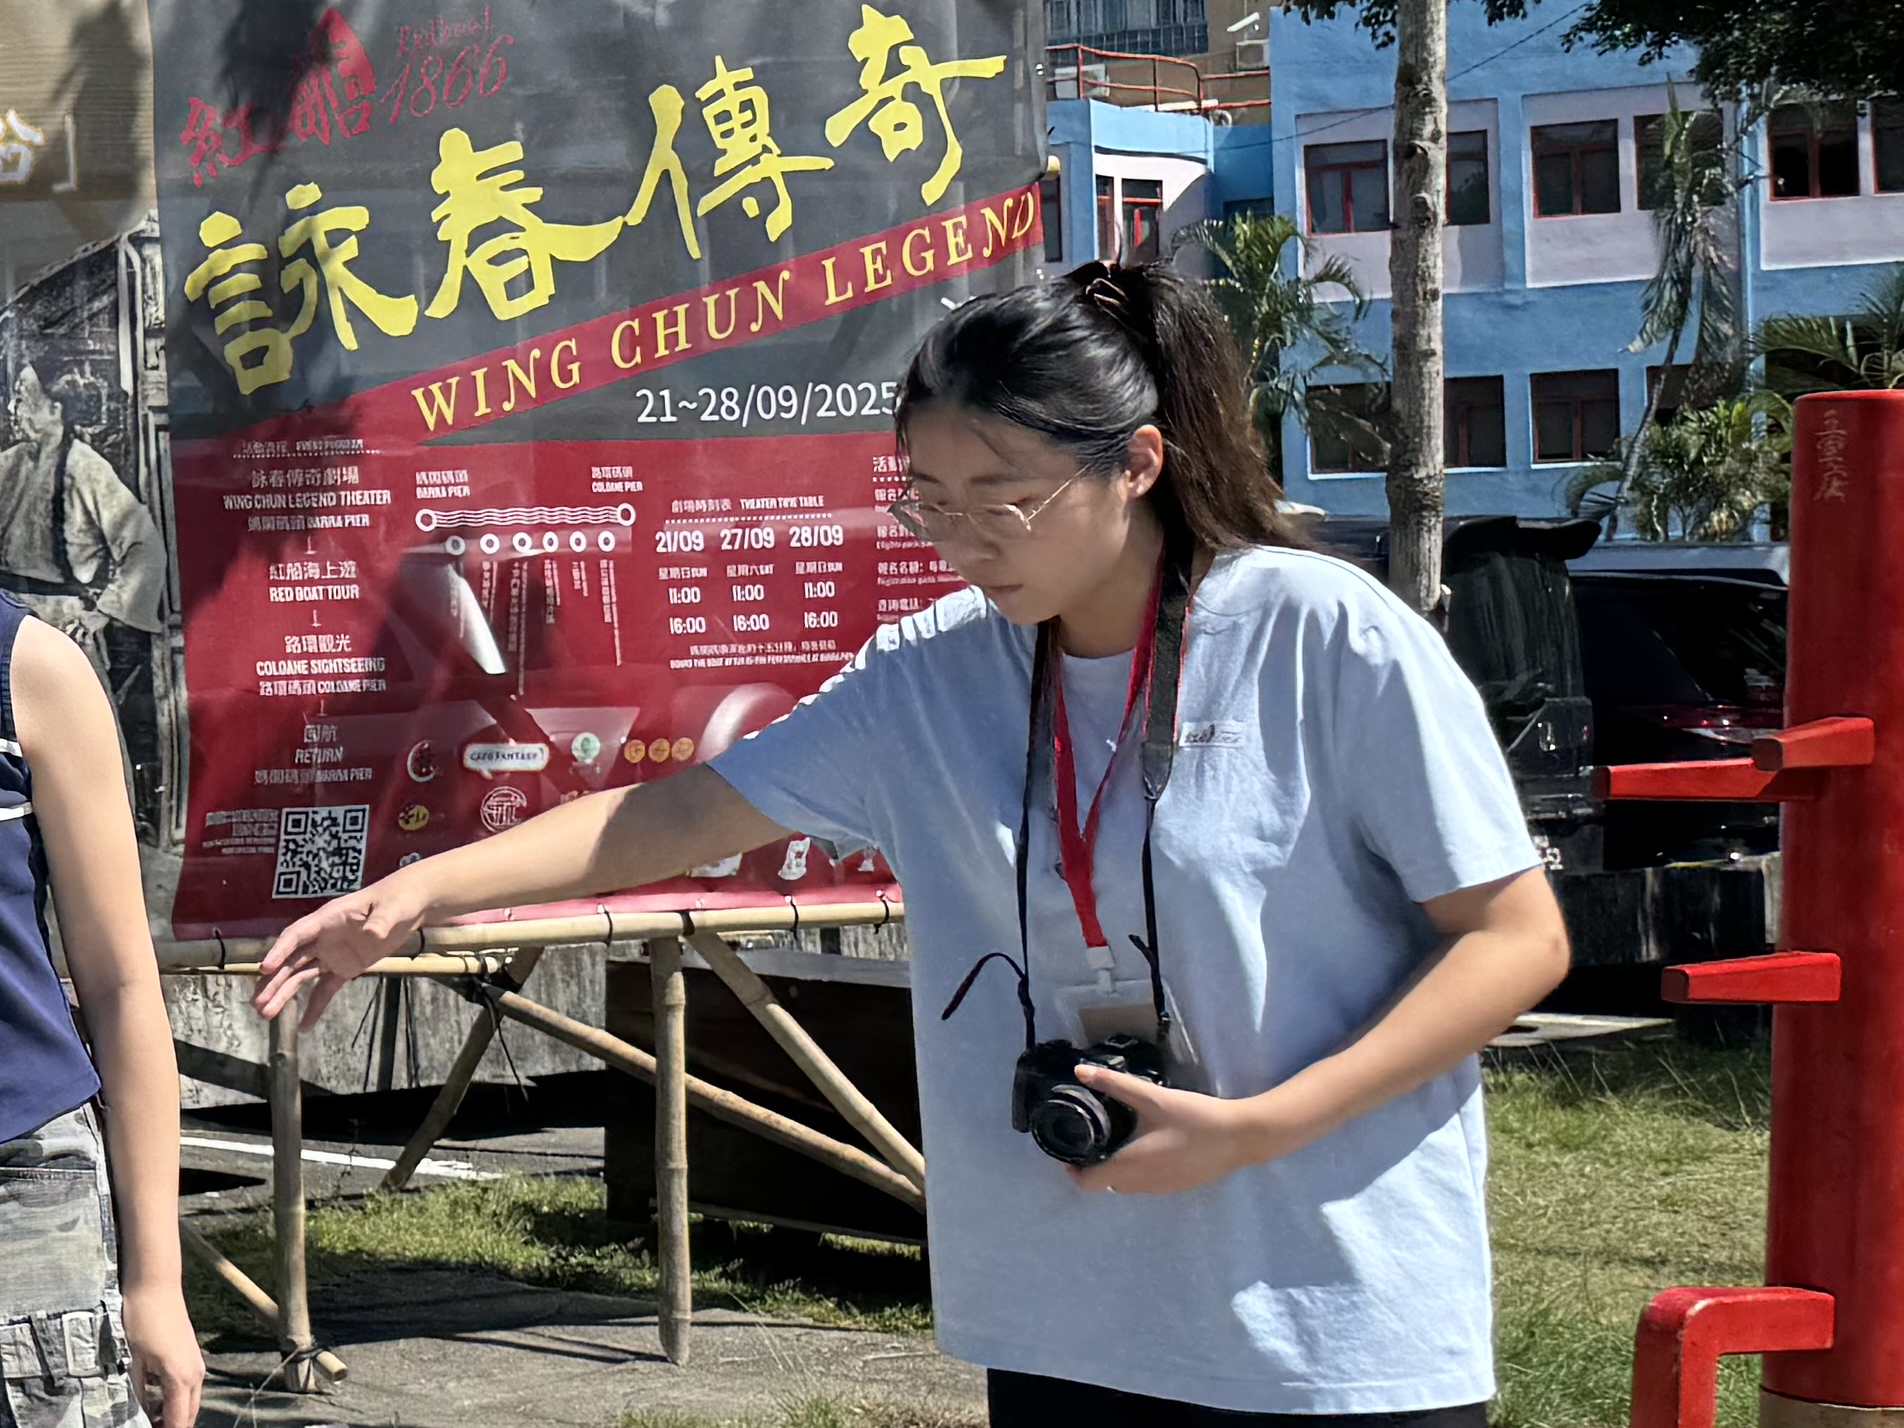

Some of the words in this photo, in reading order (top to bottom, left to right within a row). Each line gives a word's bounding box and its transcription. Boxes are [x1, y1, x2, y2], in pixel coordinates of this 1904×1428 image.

[379, 34, 515, 124] 1866
[184, 2, 1008, 396] 詠春傳奇
[411, 338, 582, 432] WING
[610, 269, 792, 370] CHUN
[822, 191, 1037, 308] LEGEND
[339, 489, 392, 507] THEATER
[655, 529, 705, 553] 21/09
[719, 527, 775, 551] 27/09
[789, 524, 844, 548] 28/09
[269, 586, 294, 603] RED
[327, 584, 360, 600] TOUR
[668, 586, 701, 604] 11:00
[732, 584, 765, 602] 11:00
[804, 581, 836, 599] 11:00
[669, 616, 706, 634] 16:00
[733, 613, 770, 632] 16:00
[804, 610, 839, 629] 16:00
